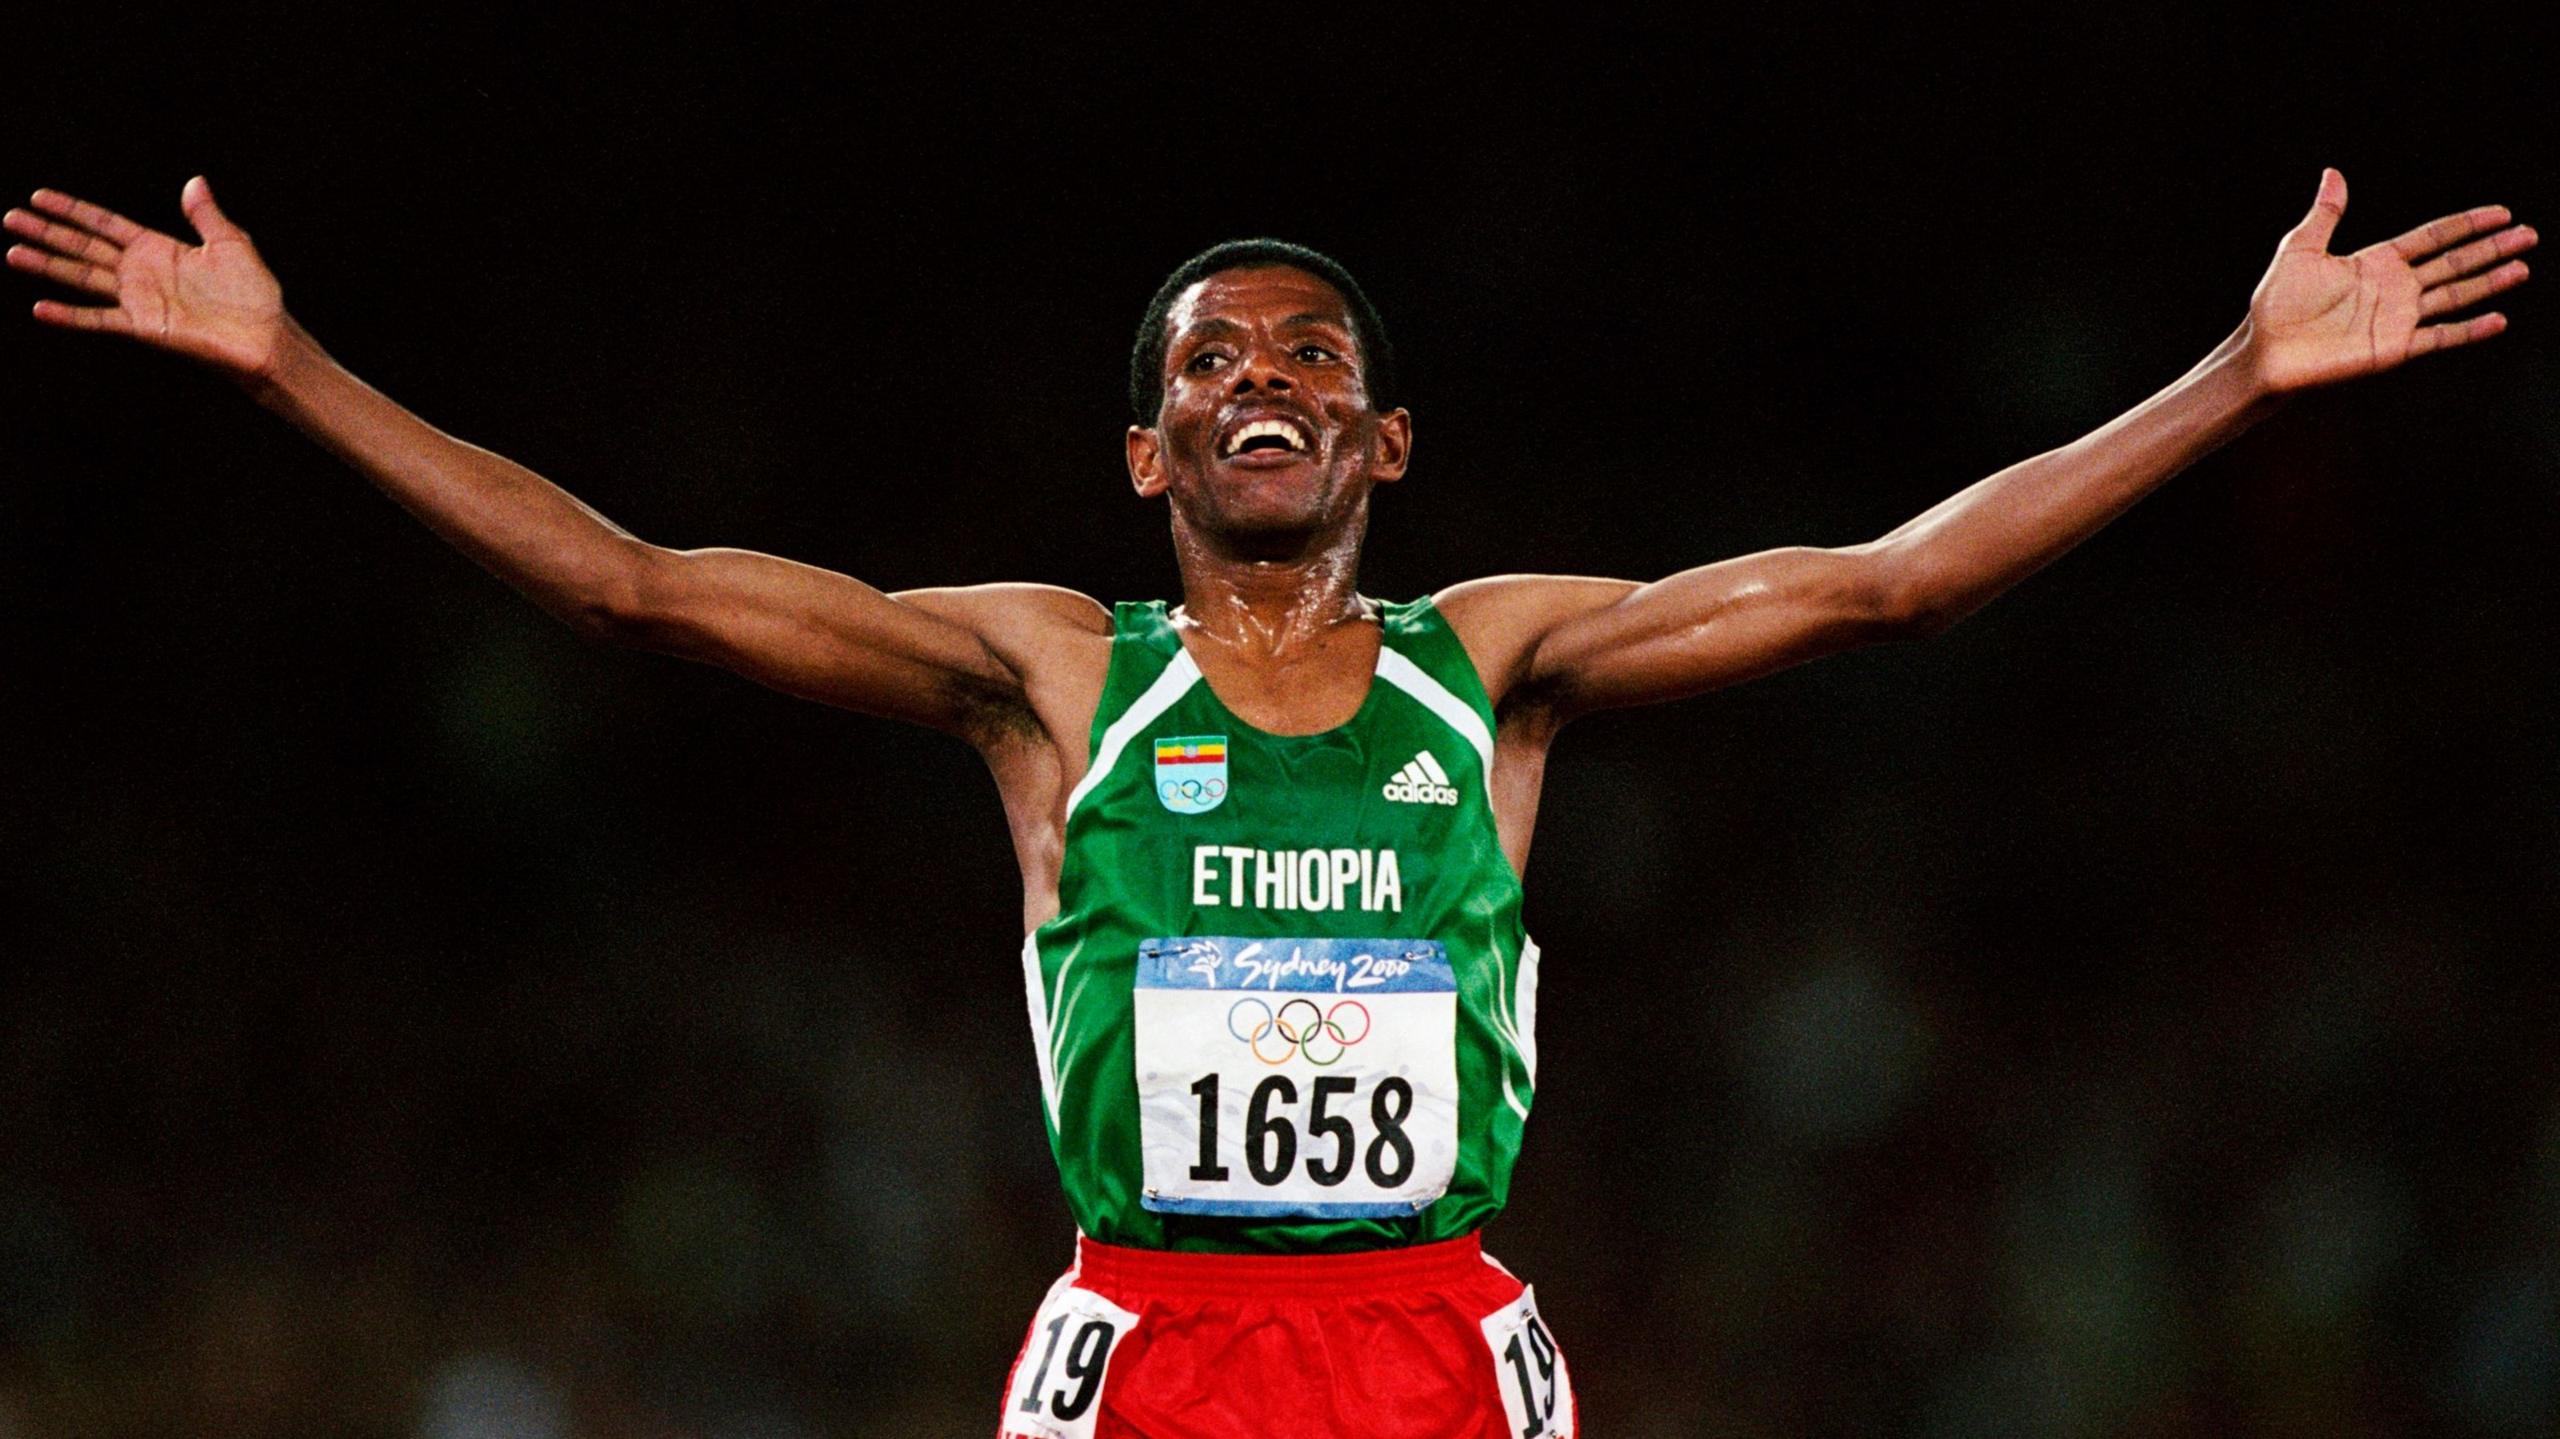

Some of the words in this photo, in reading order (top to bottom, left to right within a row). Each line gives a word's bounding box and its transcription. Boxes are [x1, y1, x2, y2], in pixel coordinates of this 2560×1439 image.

[1382, 781, 1459, 807] adidas
[1192, 845, 1402, 912] ETHIOPIA
[1234, 943, 1348, 993] Sydney
[1347, 955, 1411, 988] 2000
[1188, 1072, 1416, 1189] 1658
[1019, 1313, 1115, 1422] 19
[1504, 1317, 1557, 1439] 19
